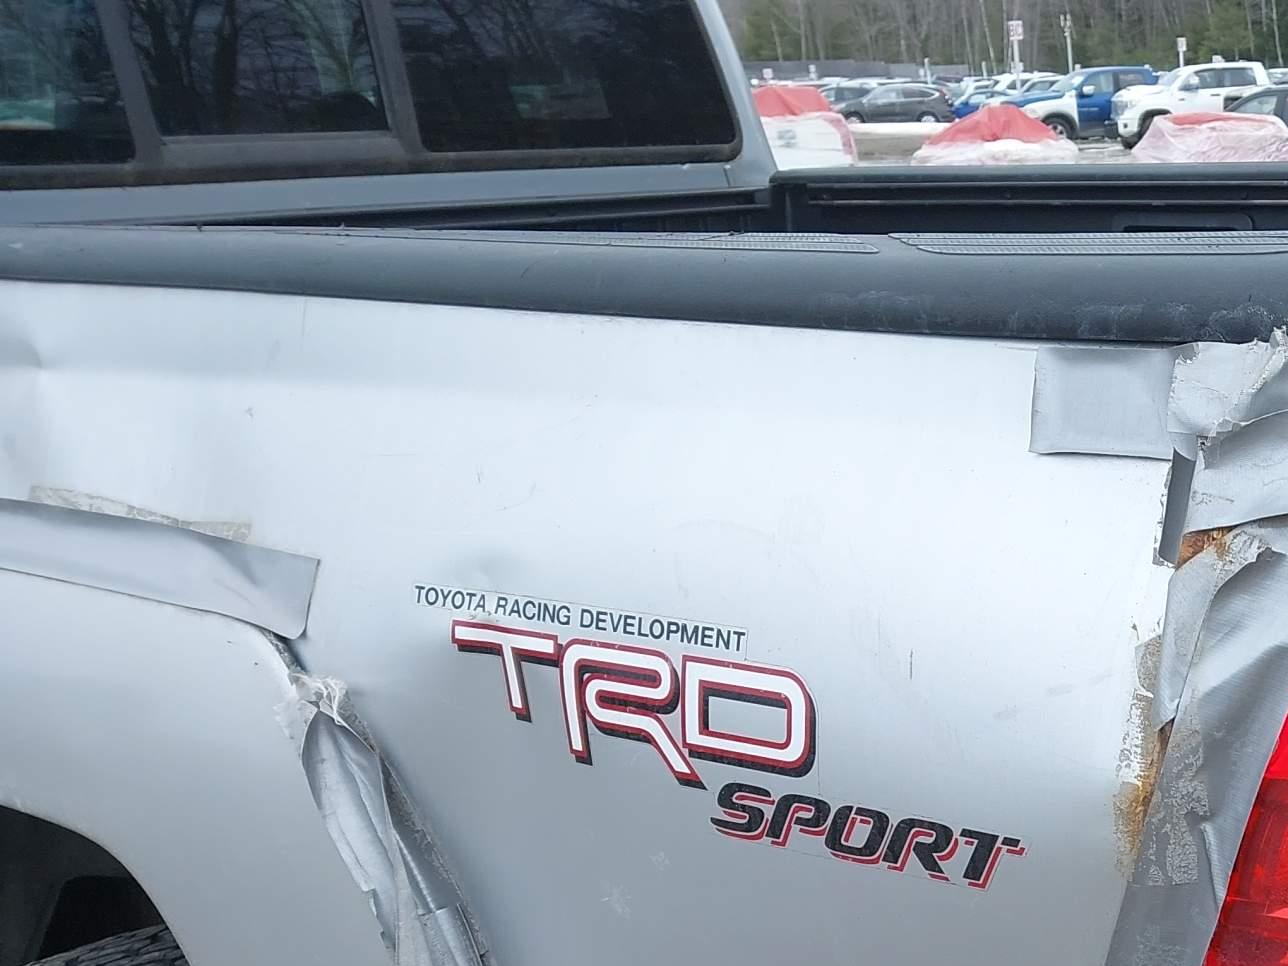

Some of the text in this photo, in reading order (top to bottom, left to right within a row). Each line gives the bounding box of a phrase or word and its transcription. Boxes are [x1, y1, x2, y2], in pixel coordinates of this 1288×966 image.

[414, 583, 746, 653] TOYOTA RACING DEVELOPMENT
[451, 618, 818, 791] TRD
[709, 781, 1028, 892] SPORT
